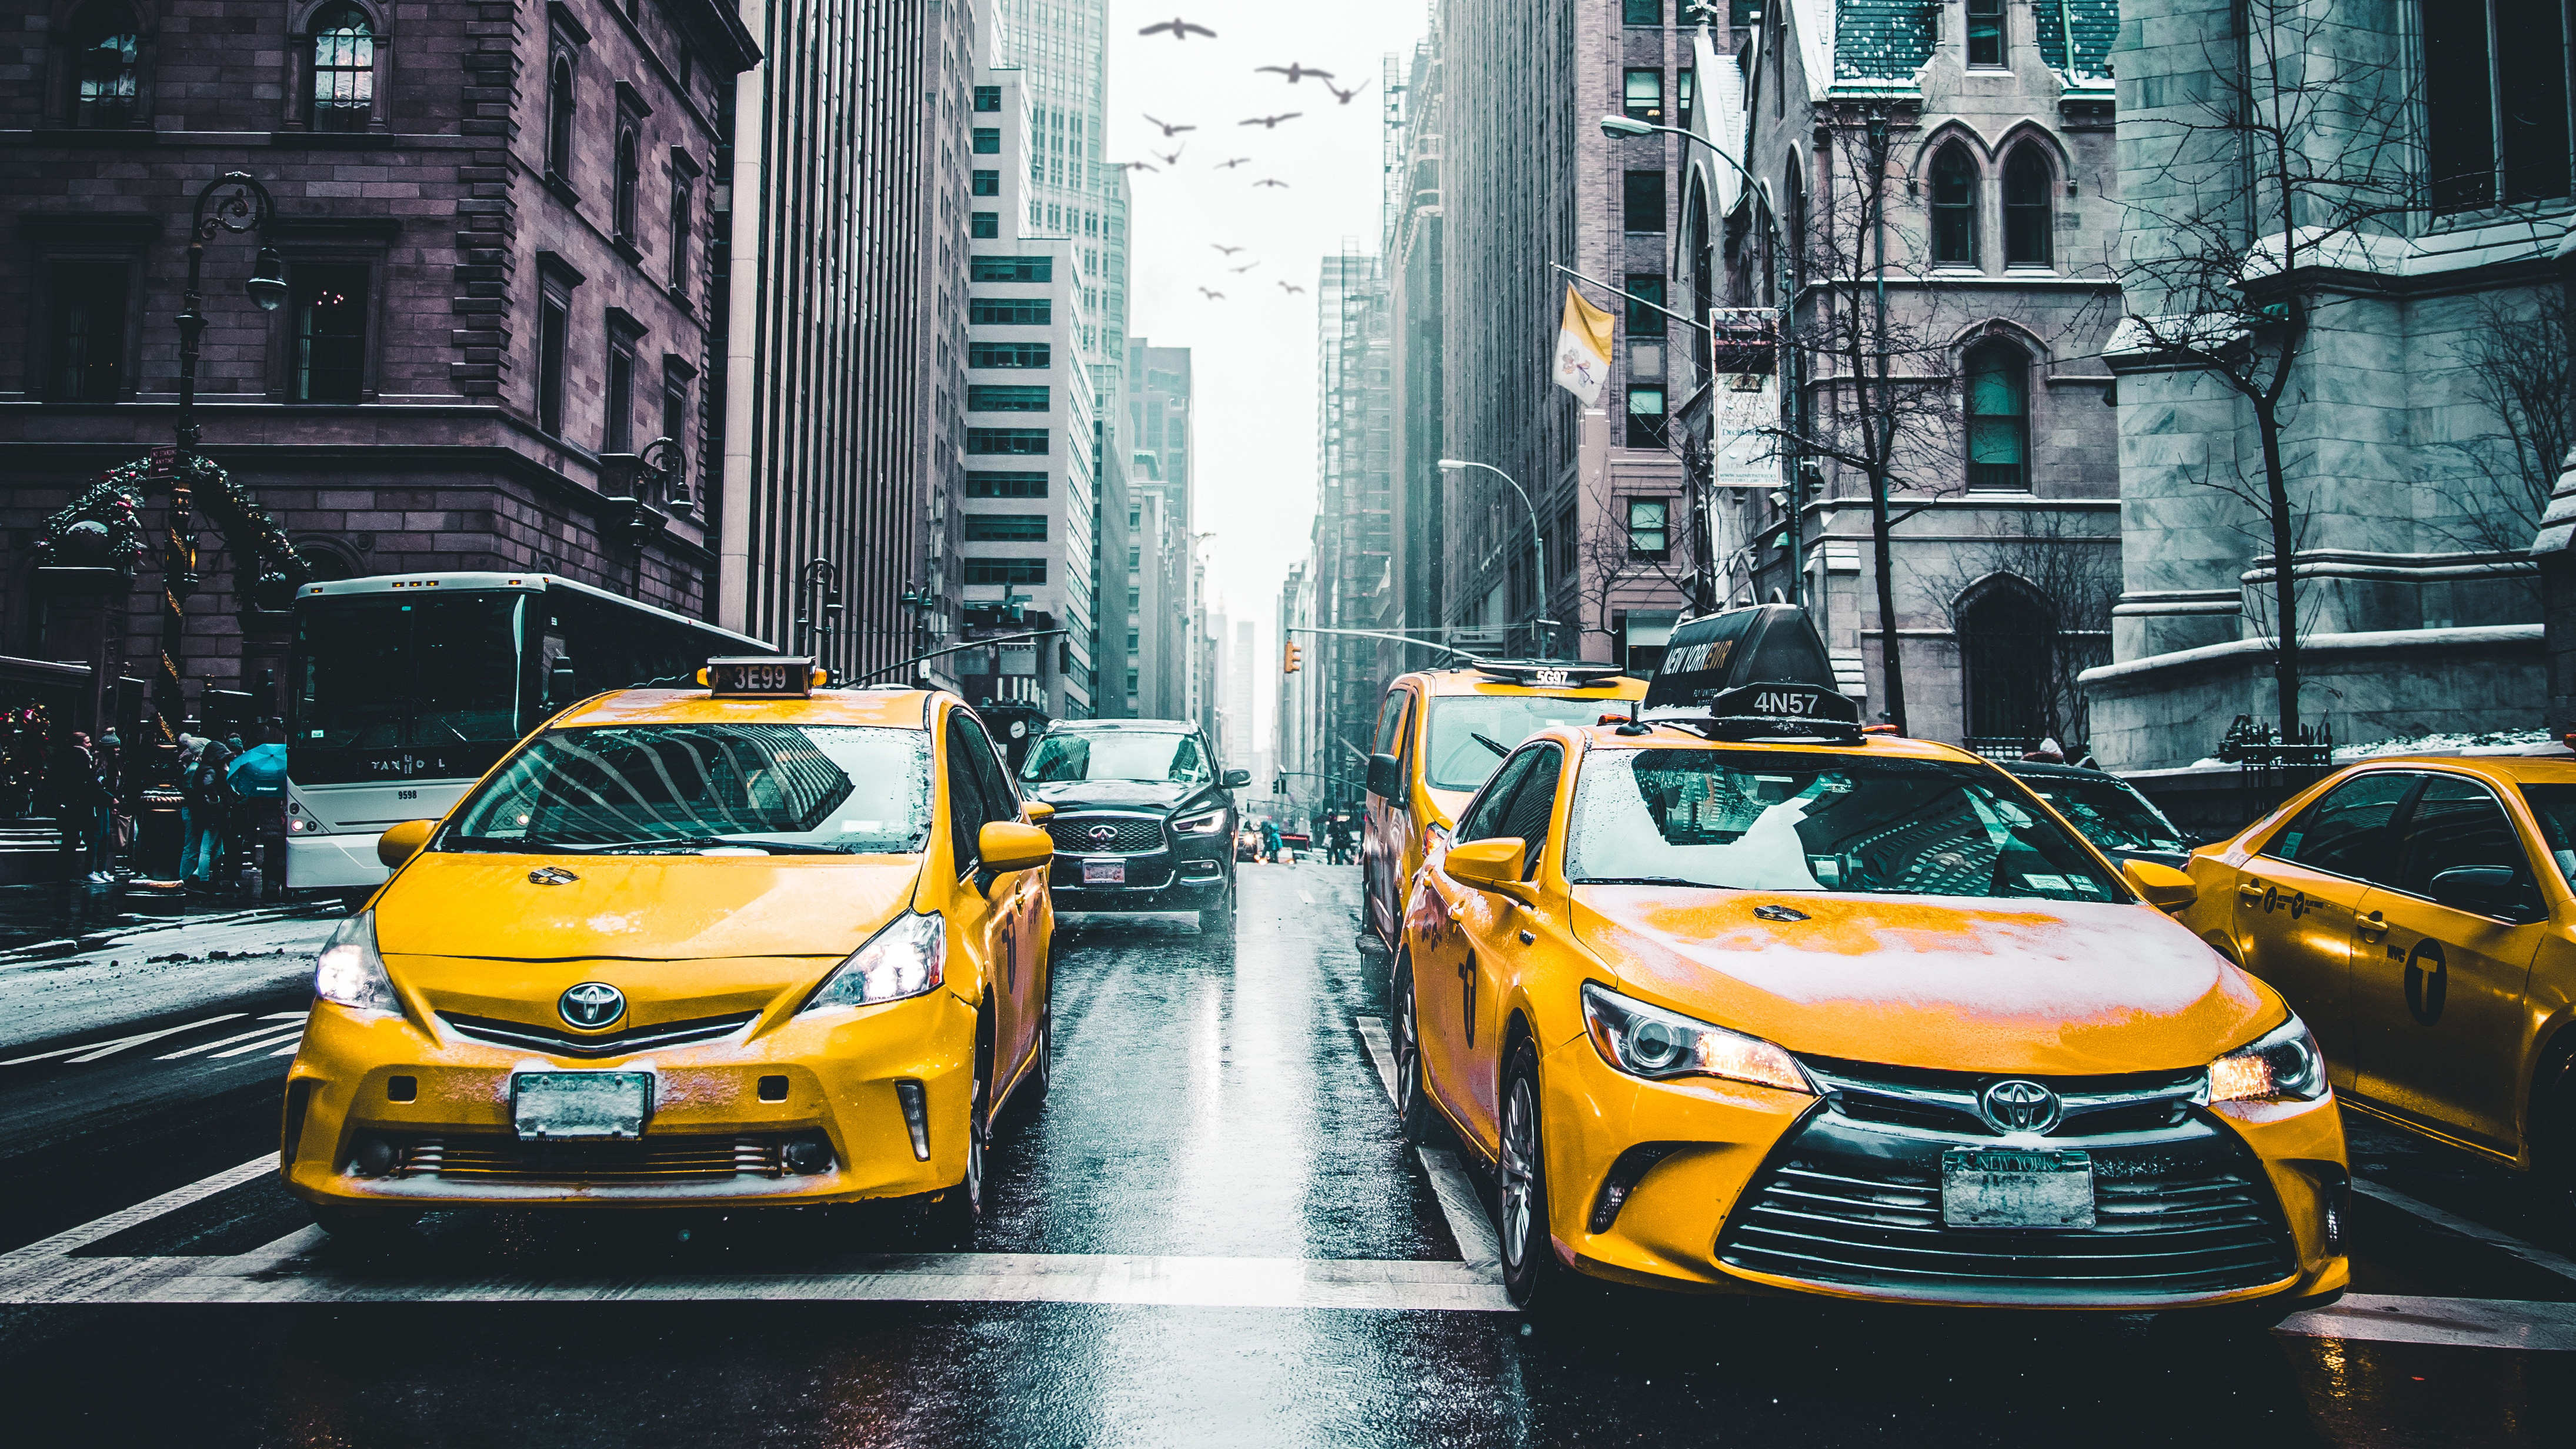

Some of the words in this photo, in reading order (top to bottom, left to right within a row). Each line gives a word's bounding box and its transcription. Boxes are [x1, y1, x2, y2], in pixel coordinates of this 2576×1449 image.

[1660, 647, 1689, 675] NEW
[735, 665, 787, 689] 3E99
[1536, 670, 1569, 685] 5G97
[1754, 692, 1818, 714] 4N57
[398, 790, 417, 800] 9598
[2387, 944, 2406, 963] NYC
[1979, 1156, 2012, 1171] NEW
[2015, 1156, 2055, 1171] YORK
